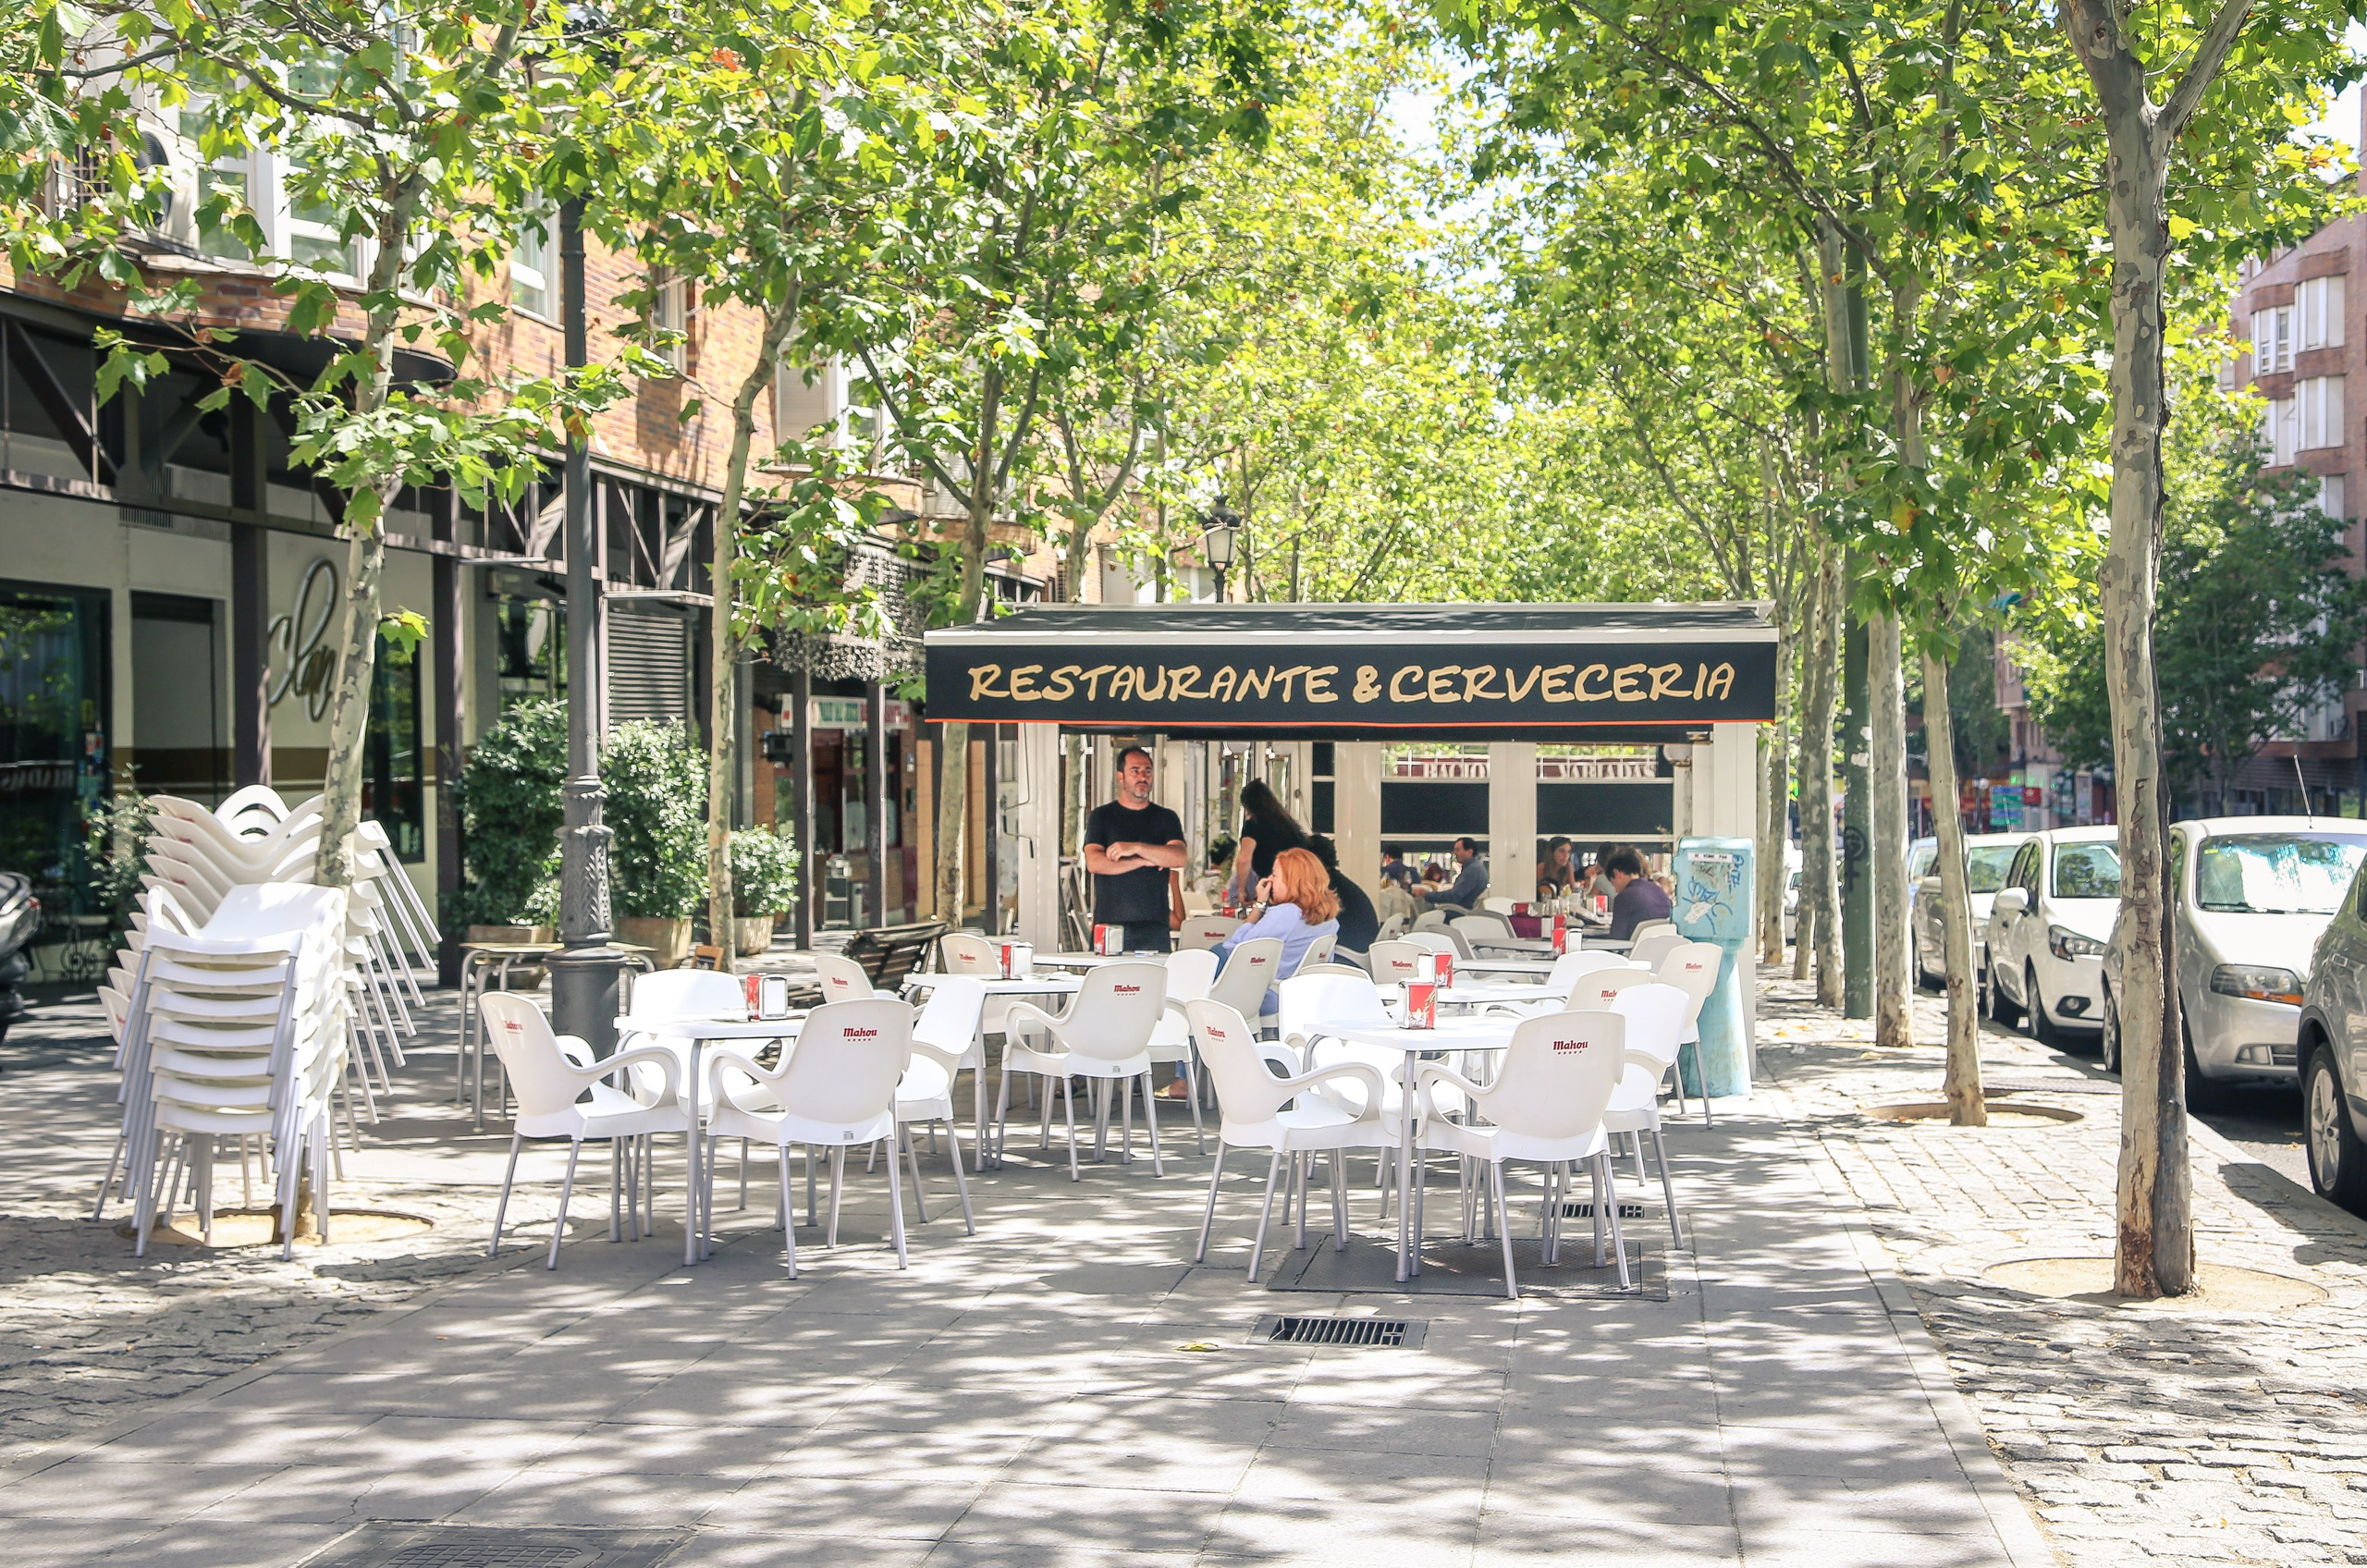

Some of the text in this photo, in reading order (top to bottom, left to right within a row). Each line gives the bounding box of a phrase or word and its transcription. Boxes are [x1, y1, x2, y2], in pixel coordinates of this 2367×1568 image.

[967, 662, 1736, 704] RESTAURANTE & CERVECERIA
[1423, 763, 1490, 778] RACIO
[1113, 984, 1141, 993] Mahou
[1600, 990, 1617, 998] Mah
[842, 1027, 878, 1037] Mahou
[1551, 1039, 1589, 1051] Mahou
